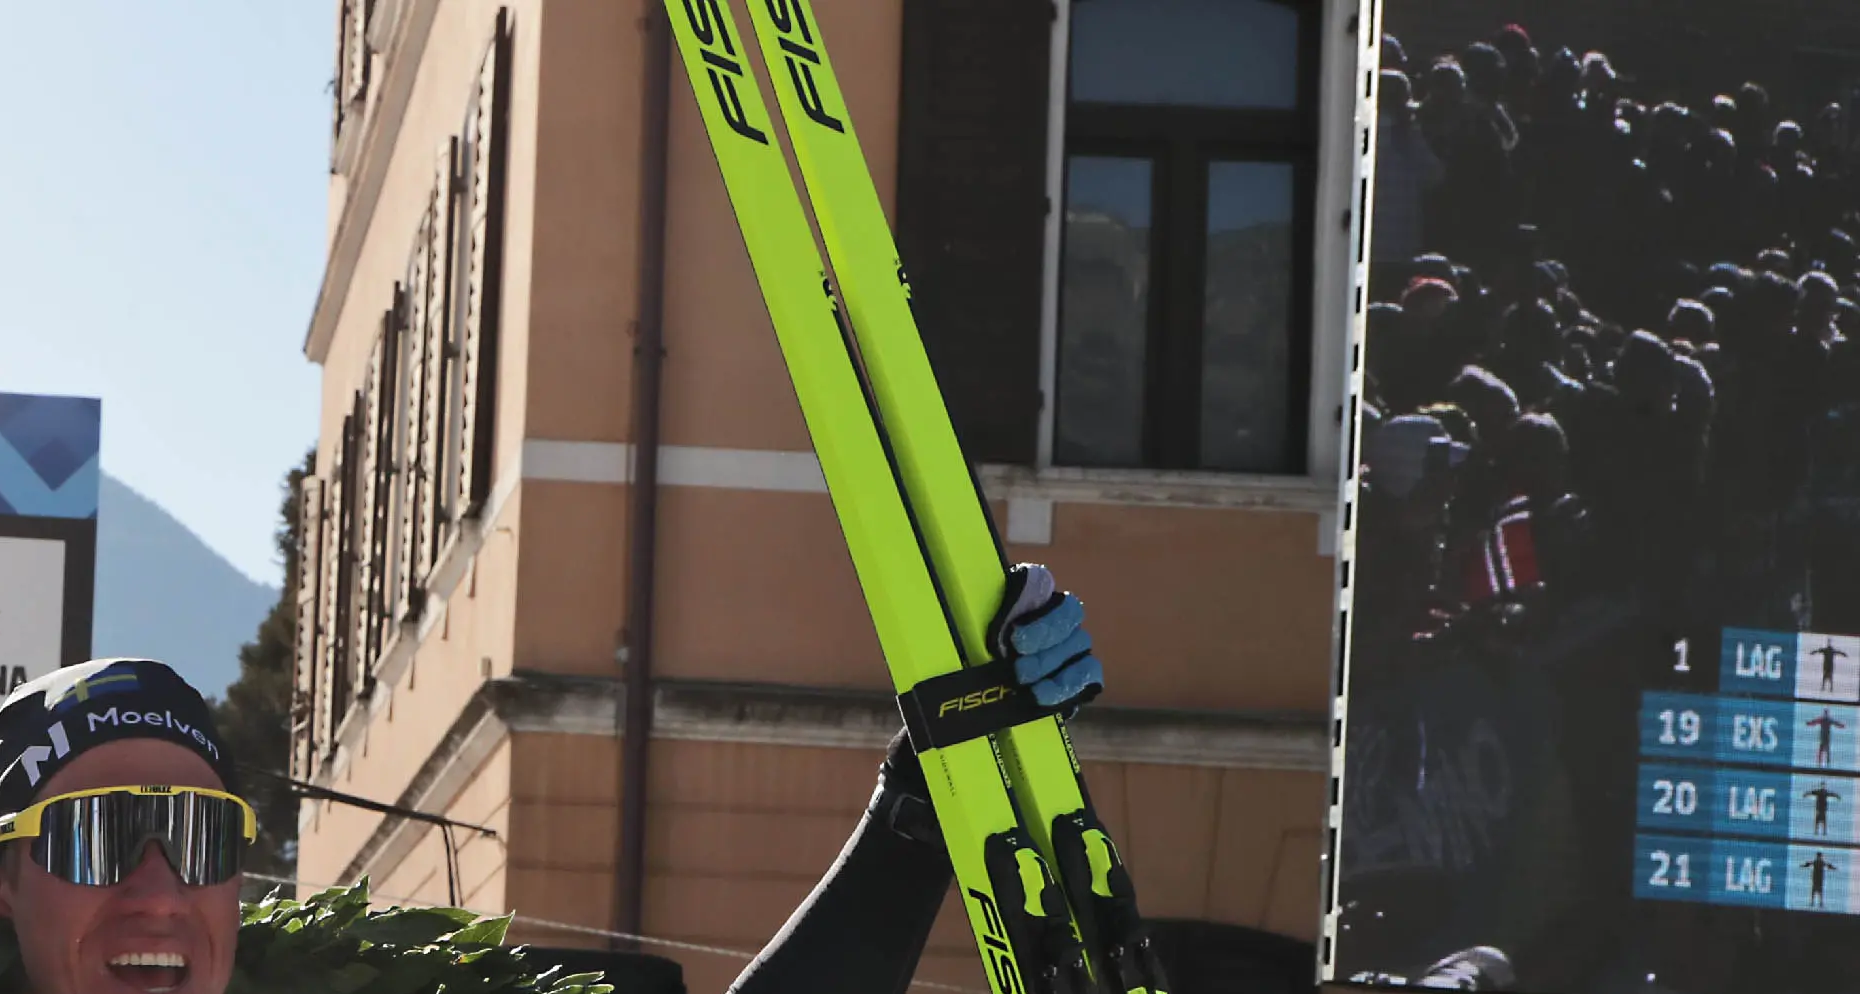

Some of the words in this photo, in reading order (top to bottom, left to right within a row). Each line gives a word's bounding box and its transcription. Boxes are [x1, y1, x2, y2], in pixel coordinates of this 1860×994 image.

[1673, 637, 1690, 672] 1
[1735, 642, 1783, 680] LAG
[86, 706, 219, 761] Moelven
[1658, 709, 1701, 745] 19
[1732, 715, 1778, 753] EXS
[1652, 779, 1696, 816] 20
[1728, 785, 1776, 822] LAG
[1649, 852, 1692, 889] 21
[1725, 856, 1772, 894] LAG
